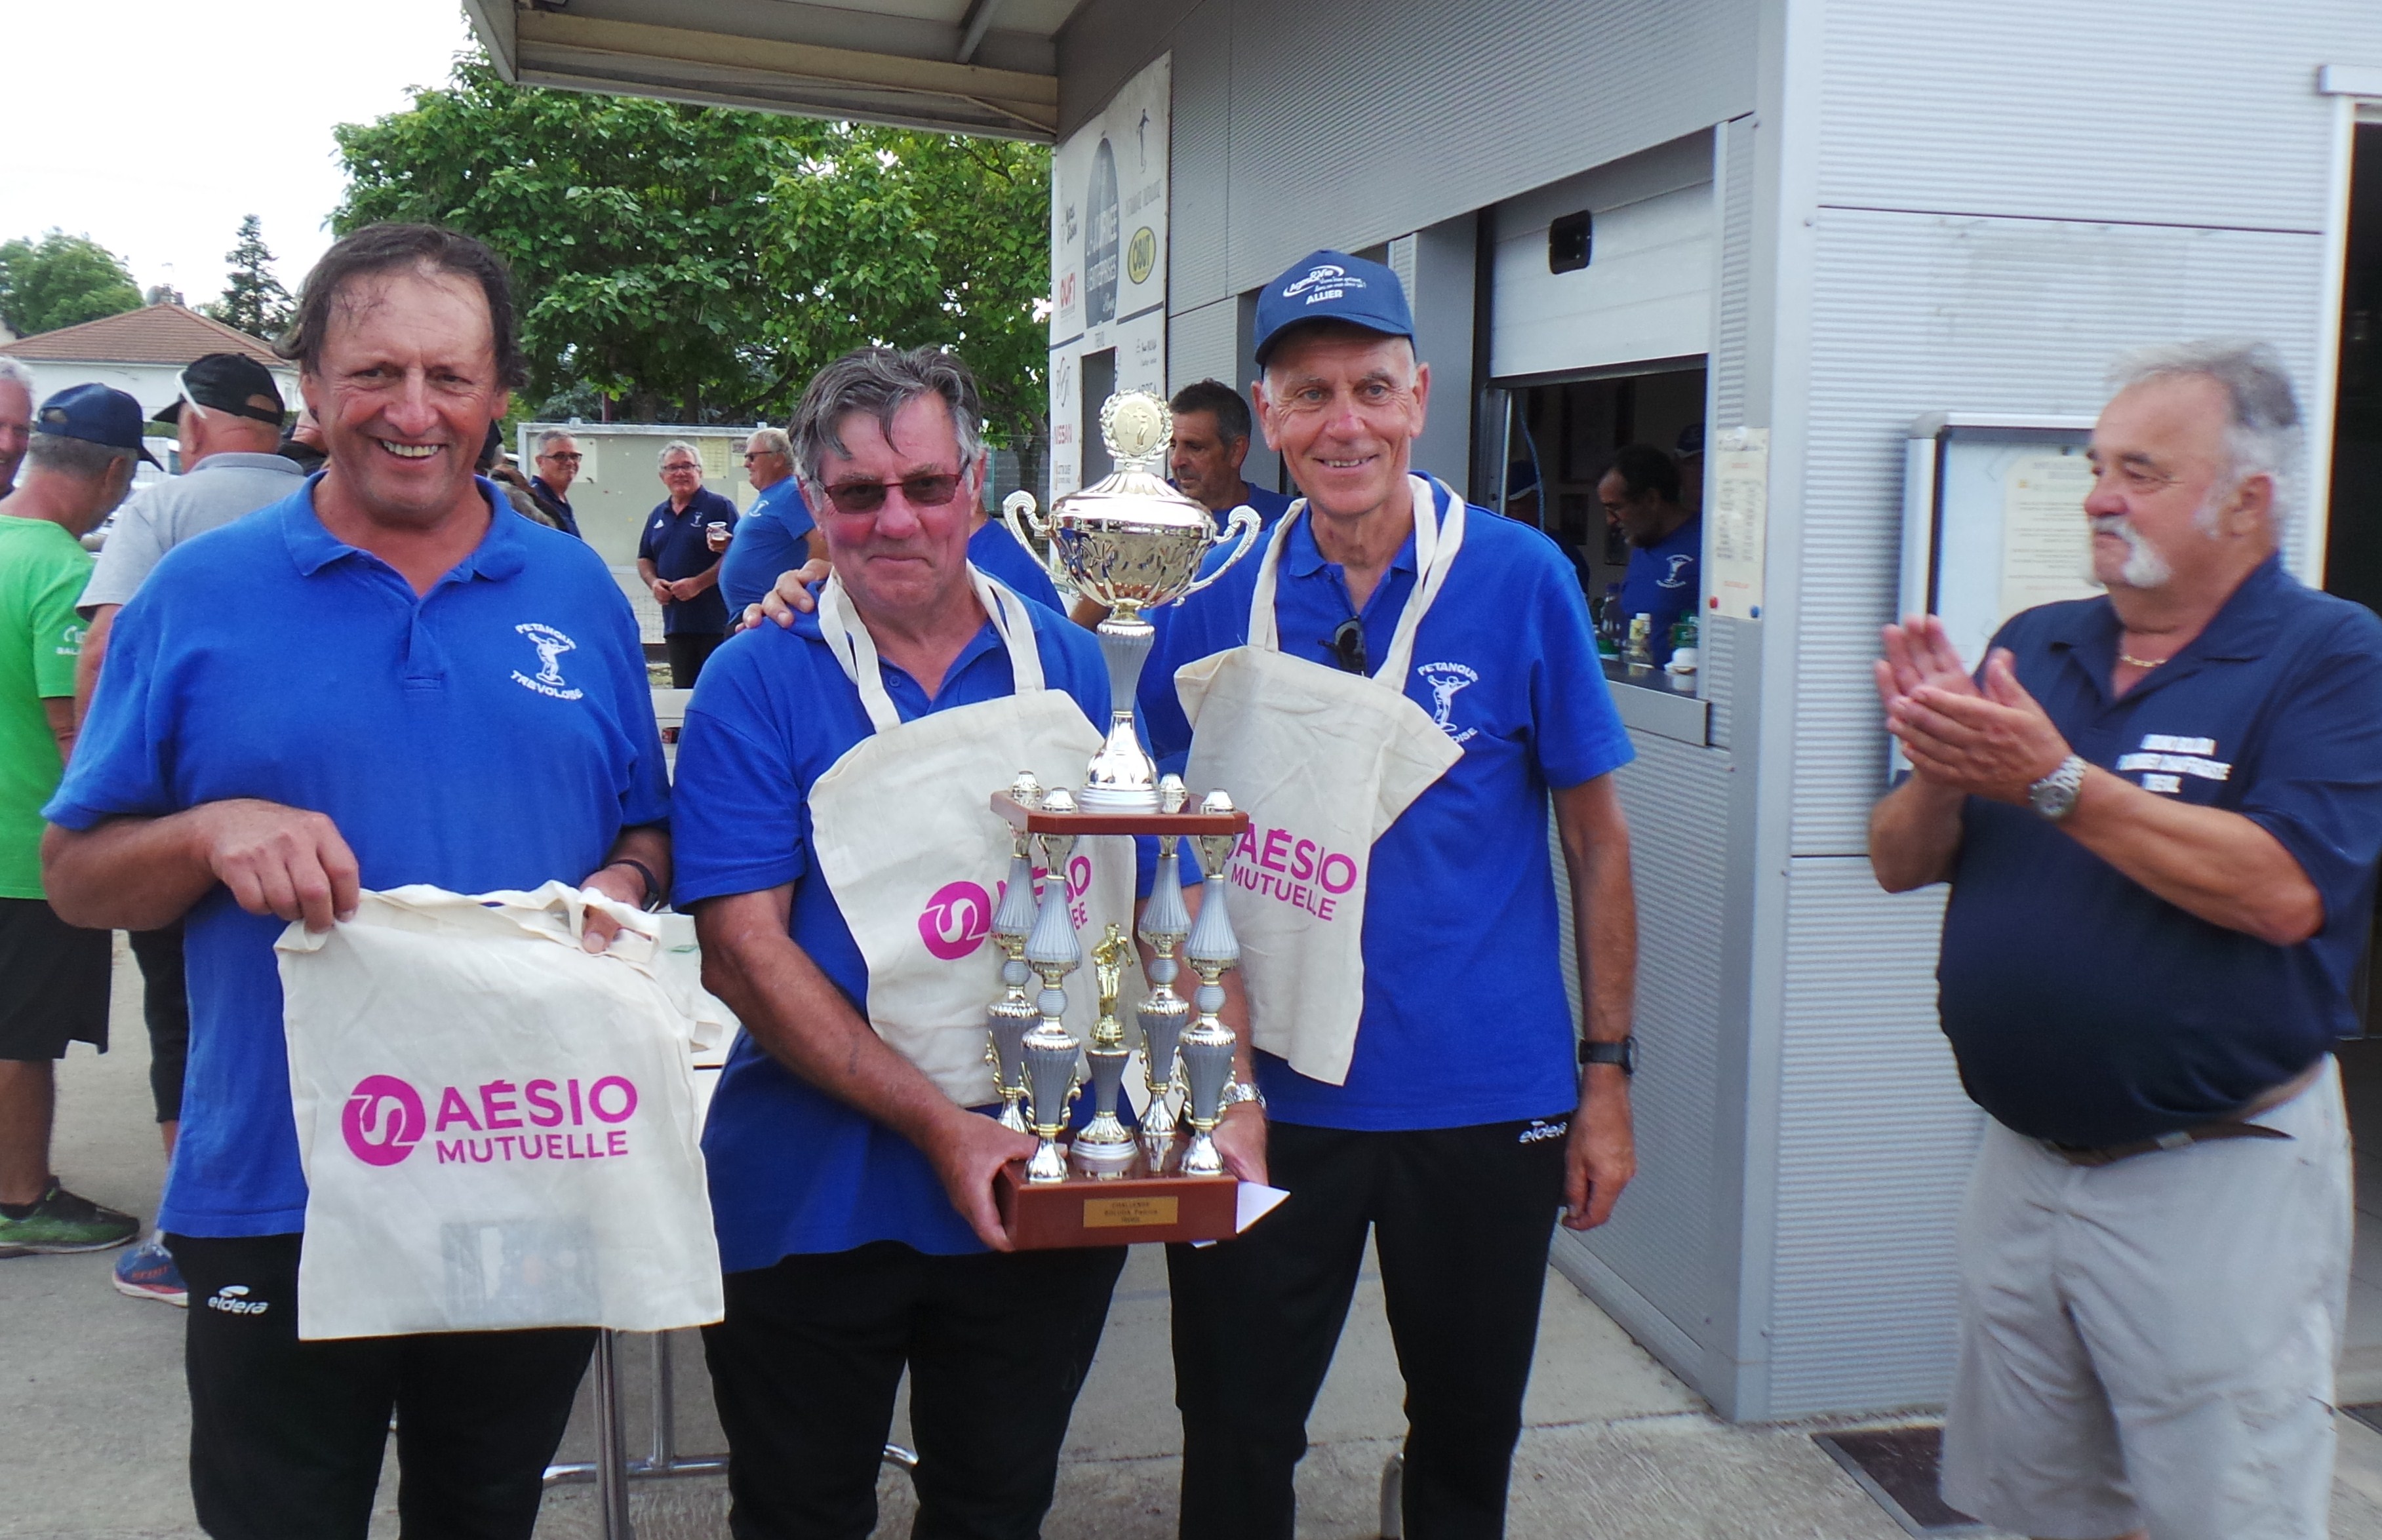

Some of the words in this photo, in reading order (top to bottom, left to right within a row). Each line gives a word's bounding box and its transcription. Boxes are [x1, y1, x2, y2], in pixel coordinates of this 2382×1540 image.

[1133, 234, 1150, 271] OBUT
[1305, 289, 1343, 305] ALLIER
[1417, 661, 1479, 682] PETANQUE
[435, 1075, 638, 1132] AÉSIO
[435, 1130, 628, 1164] MUTUELLE
[207, 1296, 269, 1315] eldera
